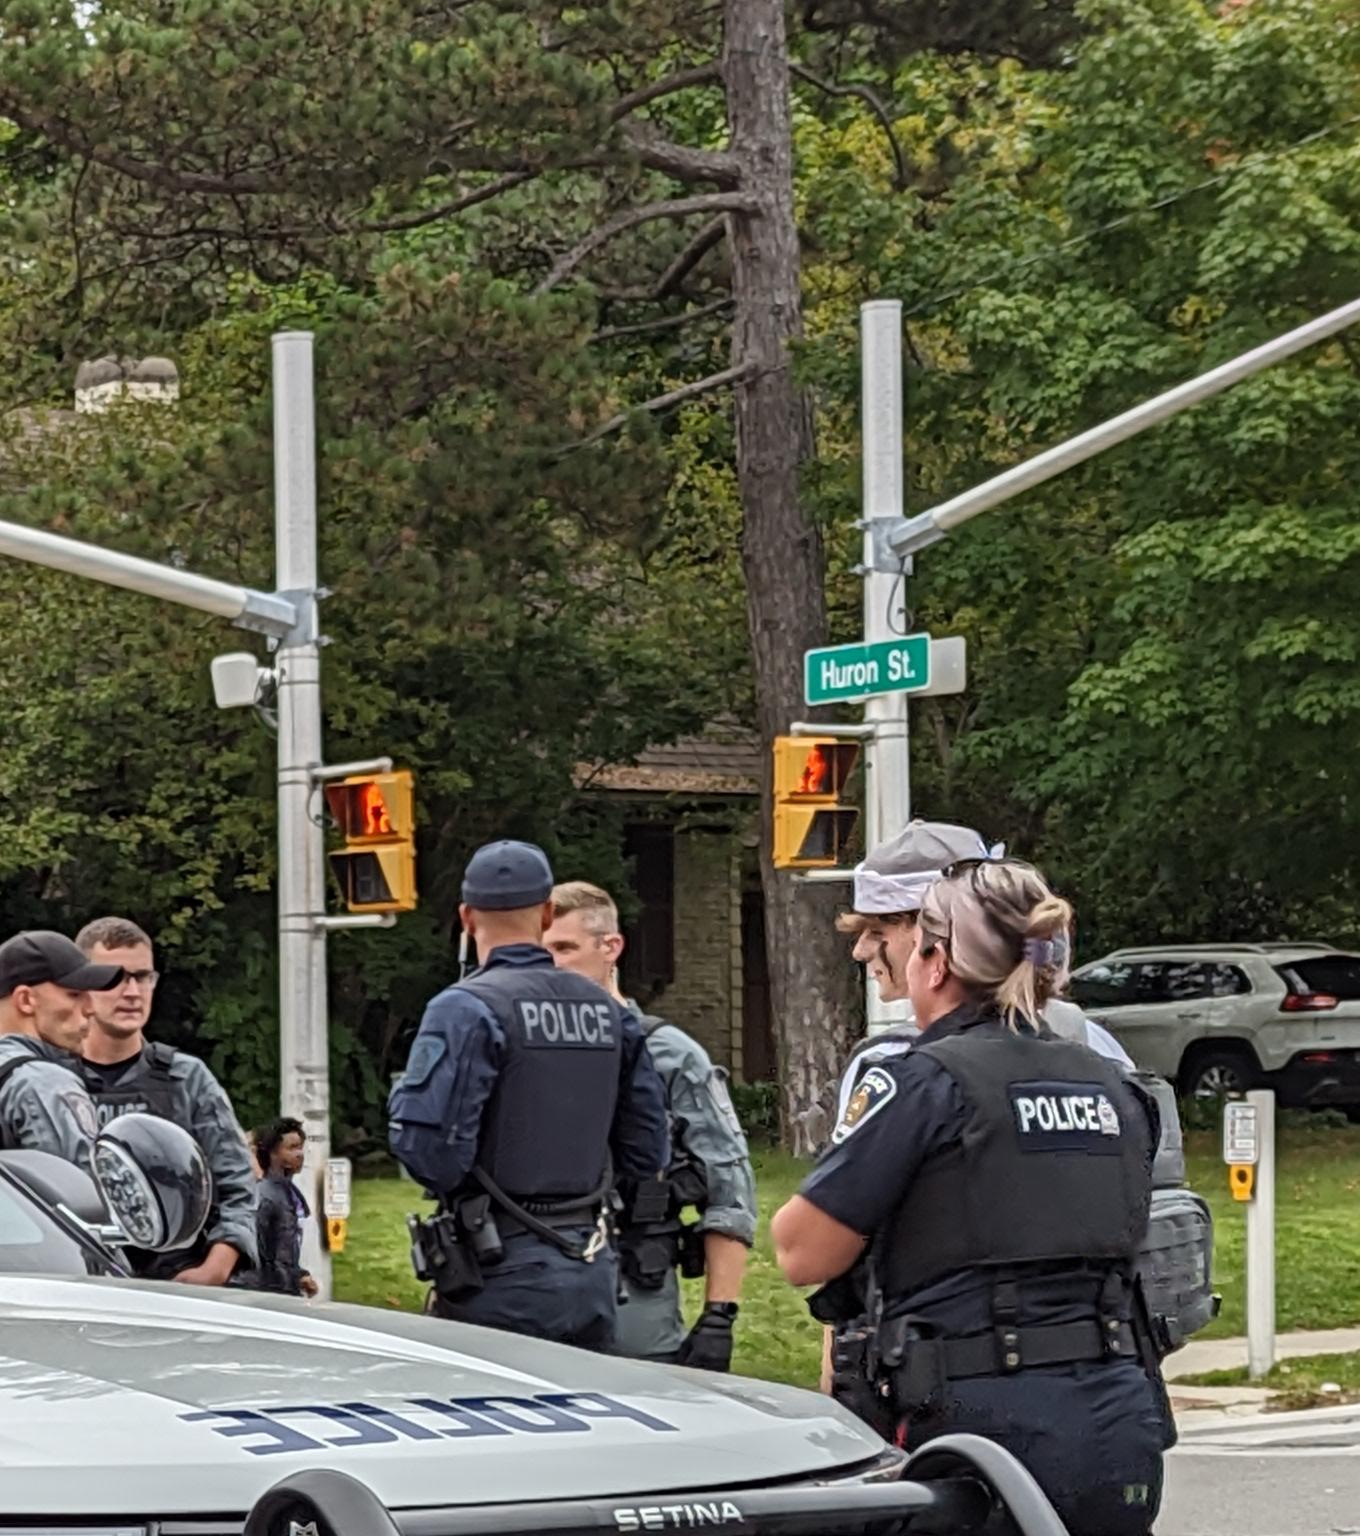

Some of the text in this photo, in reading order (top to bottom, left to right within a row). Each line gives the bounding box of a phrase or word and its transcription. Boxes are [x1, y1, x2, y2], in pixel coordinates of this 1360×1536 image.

[821, 649, 916, 690] Huron St.
[520, 1001, 614, 1044] POLICE
[1017, 1096, 1100, 1133] POLICE
[613, 1501, 745, 1532] SETINA
